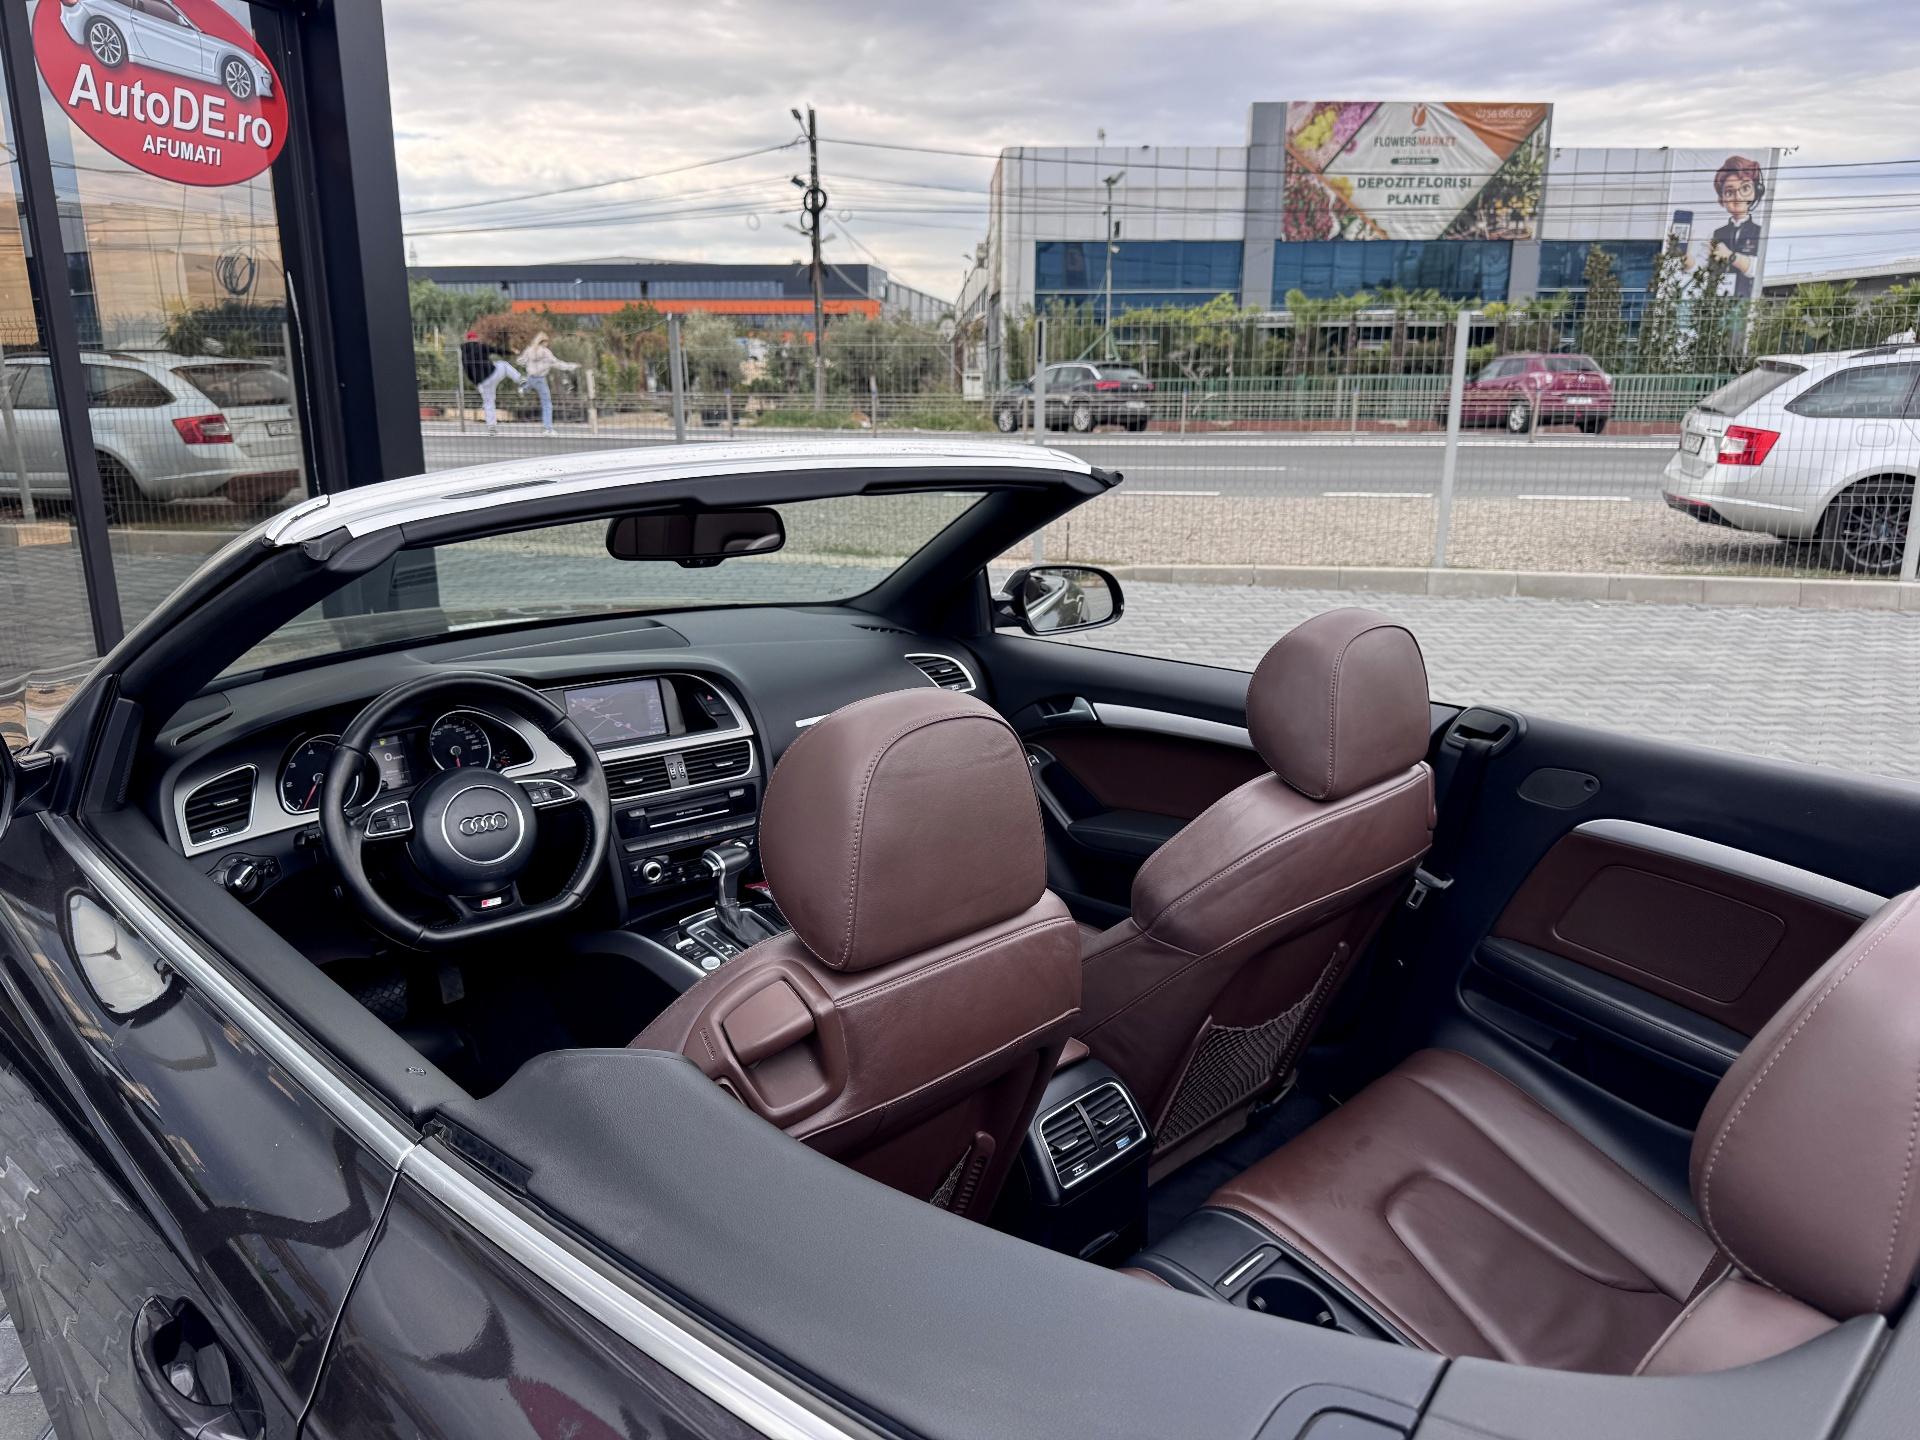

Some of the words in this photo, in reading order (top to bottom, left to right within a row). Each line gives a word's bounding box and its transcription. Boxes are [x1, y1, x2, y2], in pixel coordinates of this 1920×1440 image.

[68, 63, 274, 149] AutoDE.ro
[141, 134, 222, 167] AFUMATI
[1357, 177, 1416, 189] DEPOZIT
[1417, 177, 1457, 189] FLORI
[1387, 194, 1441, 205] PLANTE
